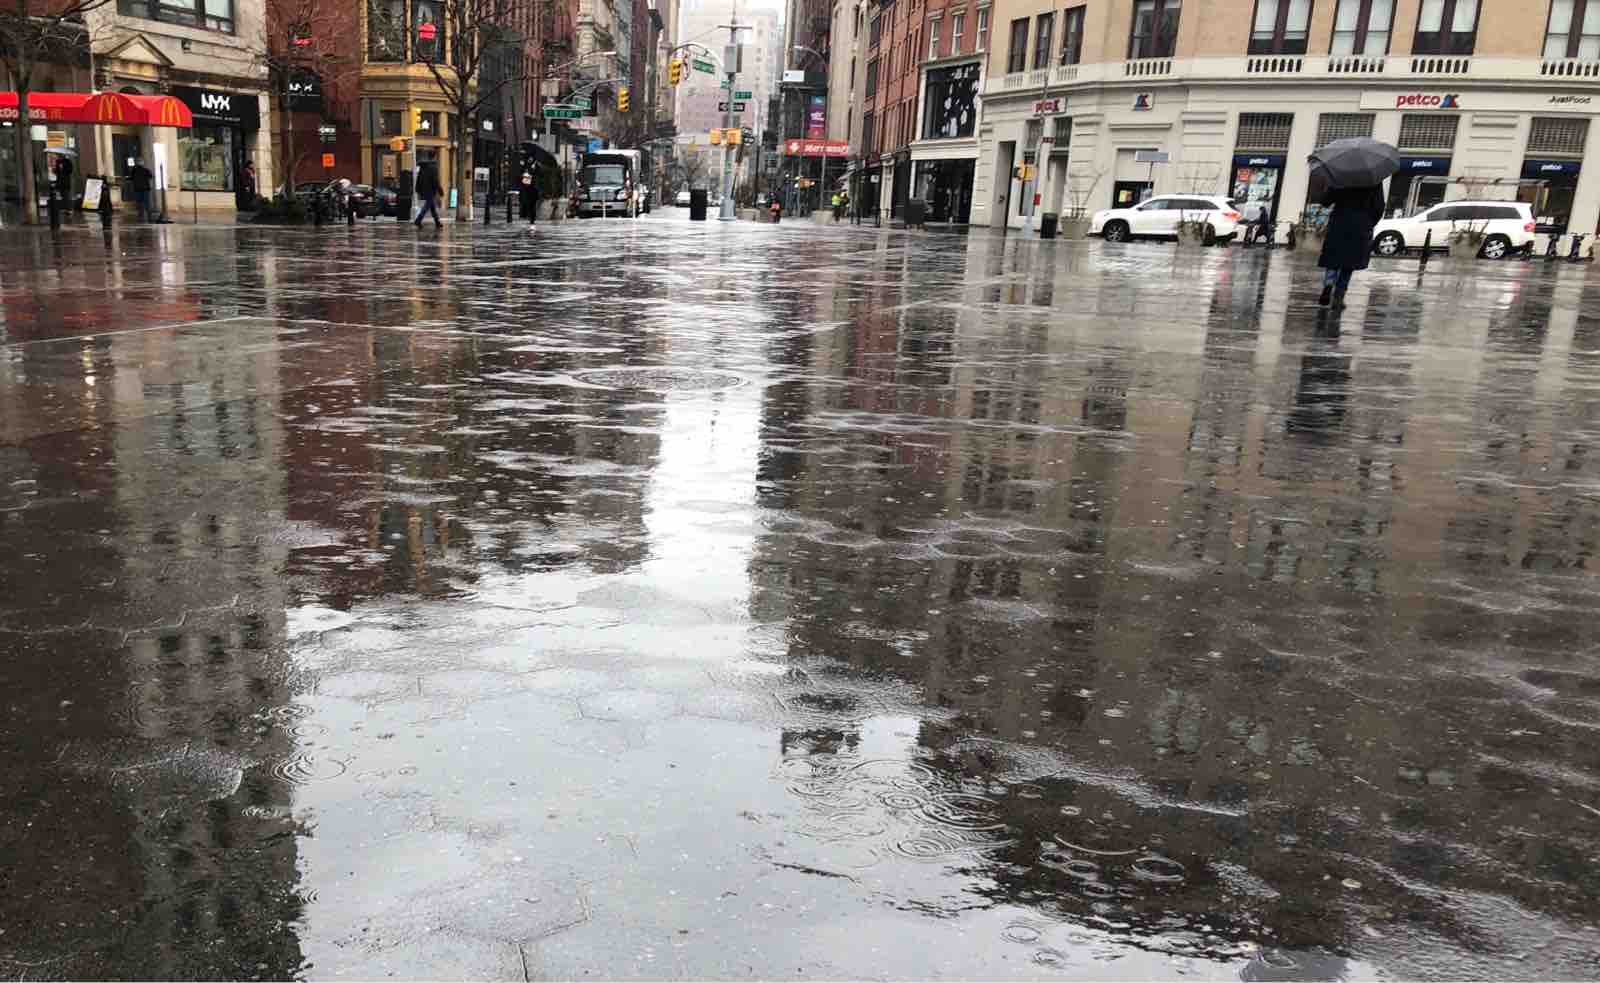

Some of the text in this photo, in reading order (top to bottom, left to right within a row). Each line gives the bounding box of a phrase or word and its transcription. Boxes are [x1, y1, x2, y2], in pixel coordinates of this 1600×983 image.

[201, 93, 230, 111] NYX
[1396, 94, 1440, 110] petco
[1412, 159, 1433, 168] petco
